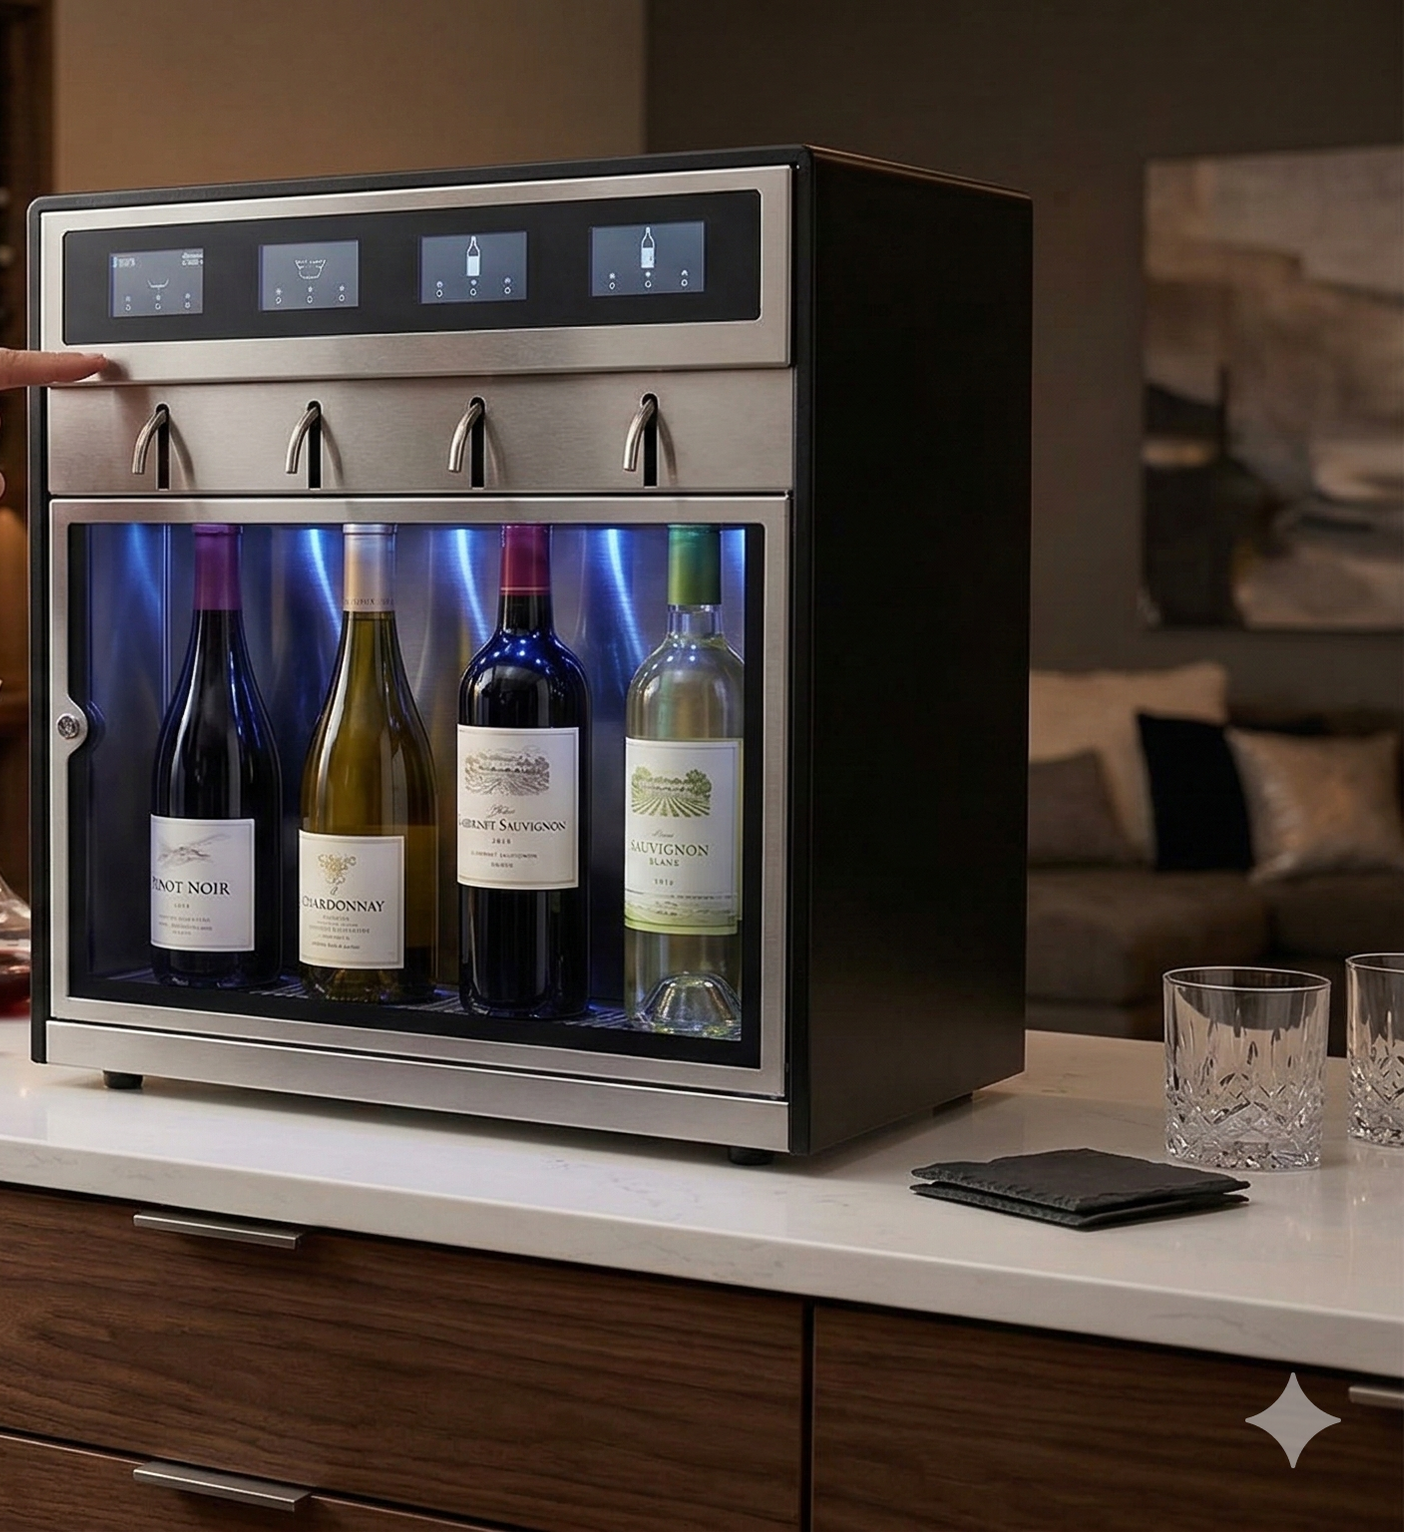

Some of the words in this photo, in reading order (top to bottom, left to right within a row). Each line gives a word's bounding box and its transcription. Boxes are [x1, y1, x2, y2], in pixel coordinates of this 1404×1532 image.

[499, 818, 566, 832] SAUVIGNON
[630, 839, 709, 856] SAUVIGNON
[188, 880, 230, 895] NOIR
